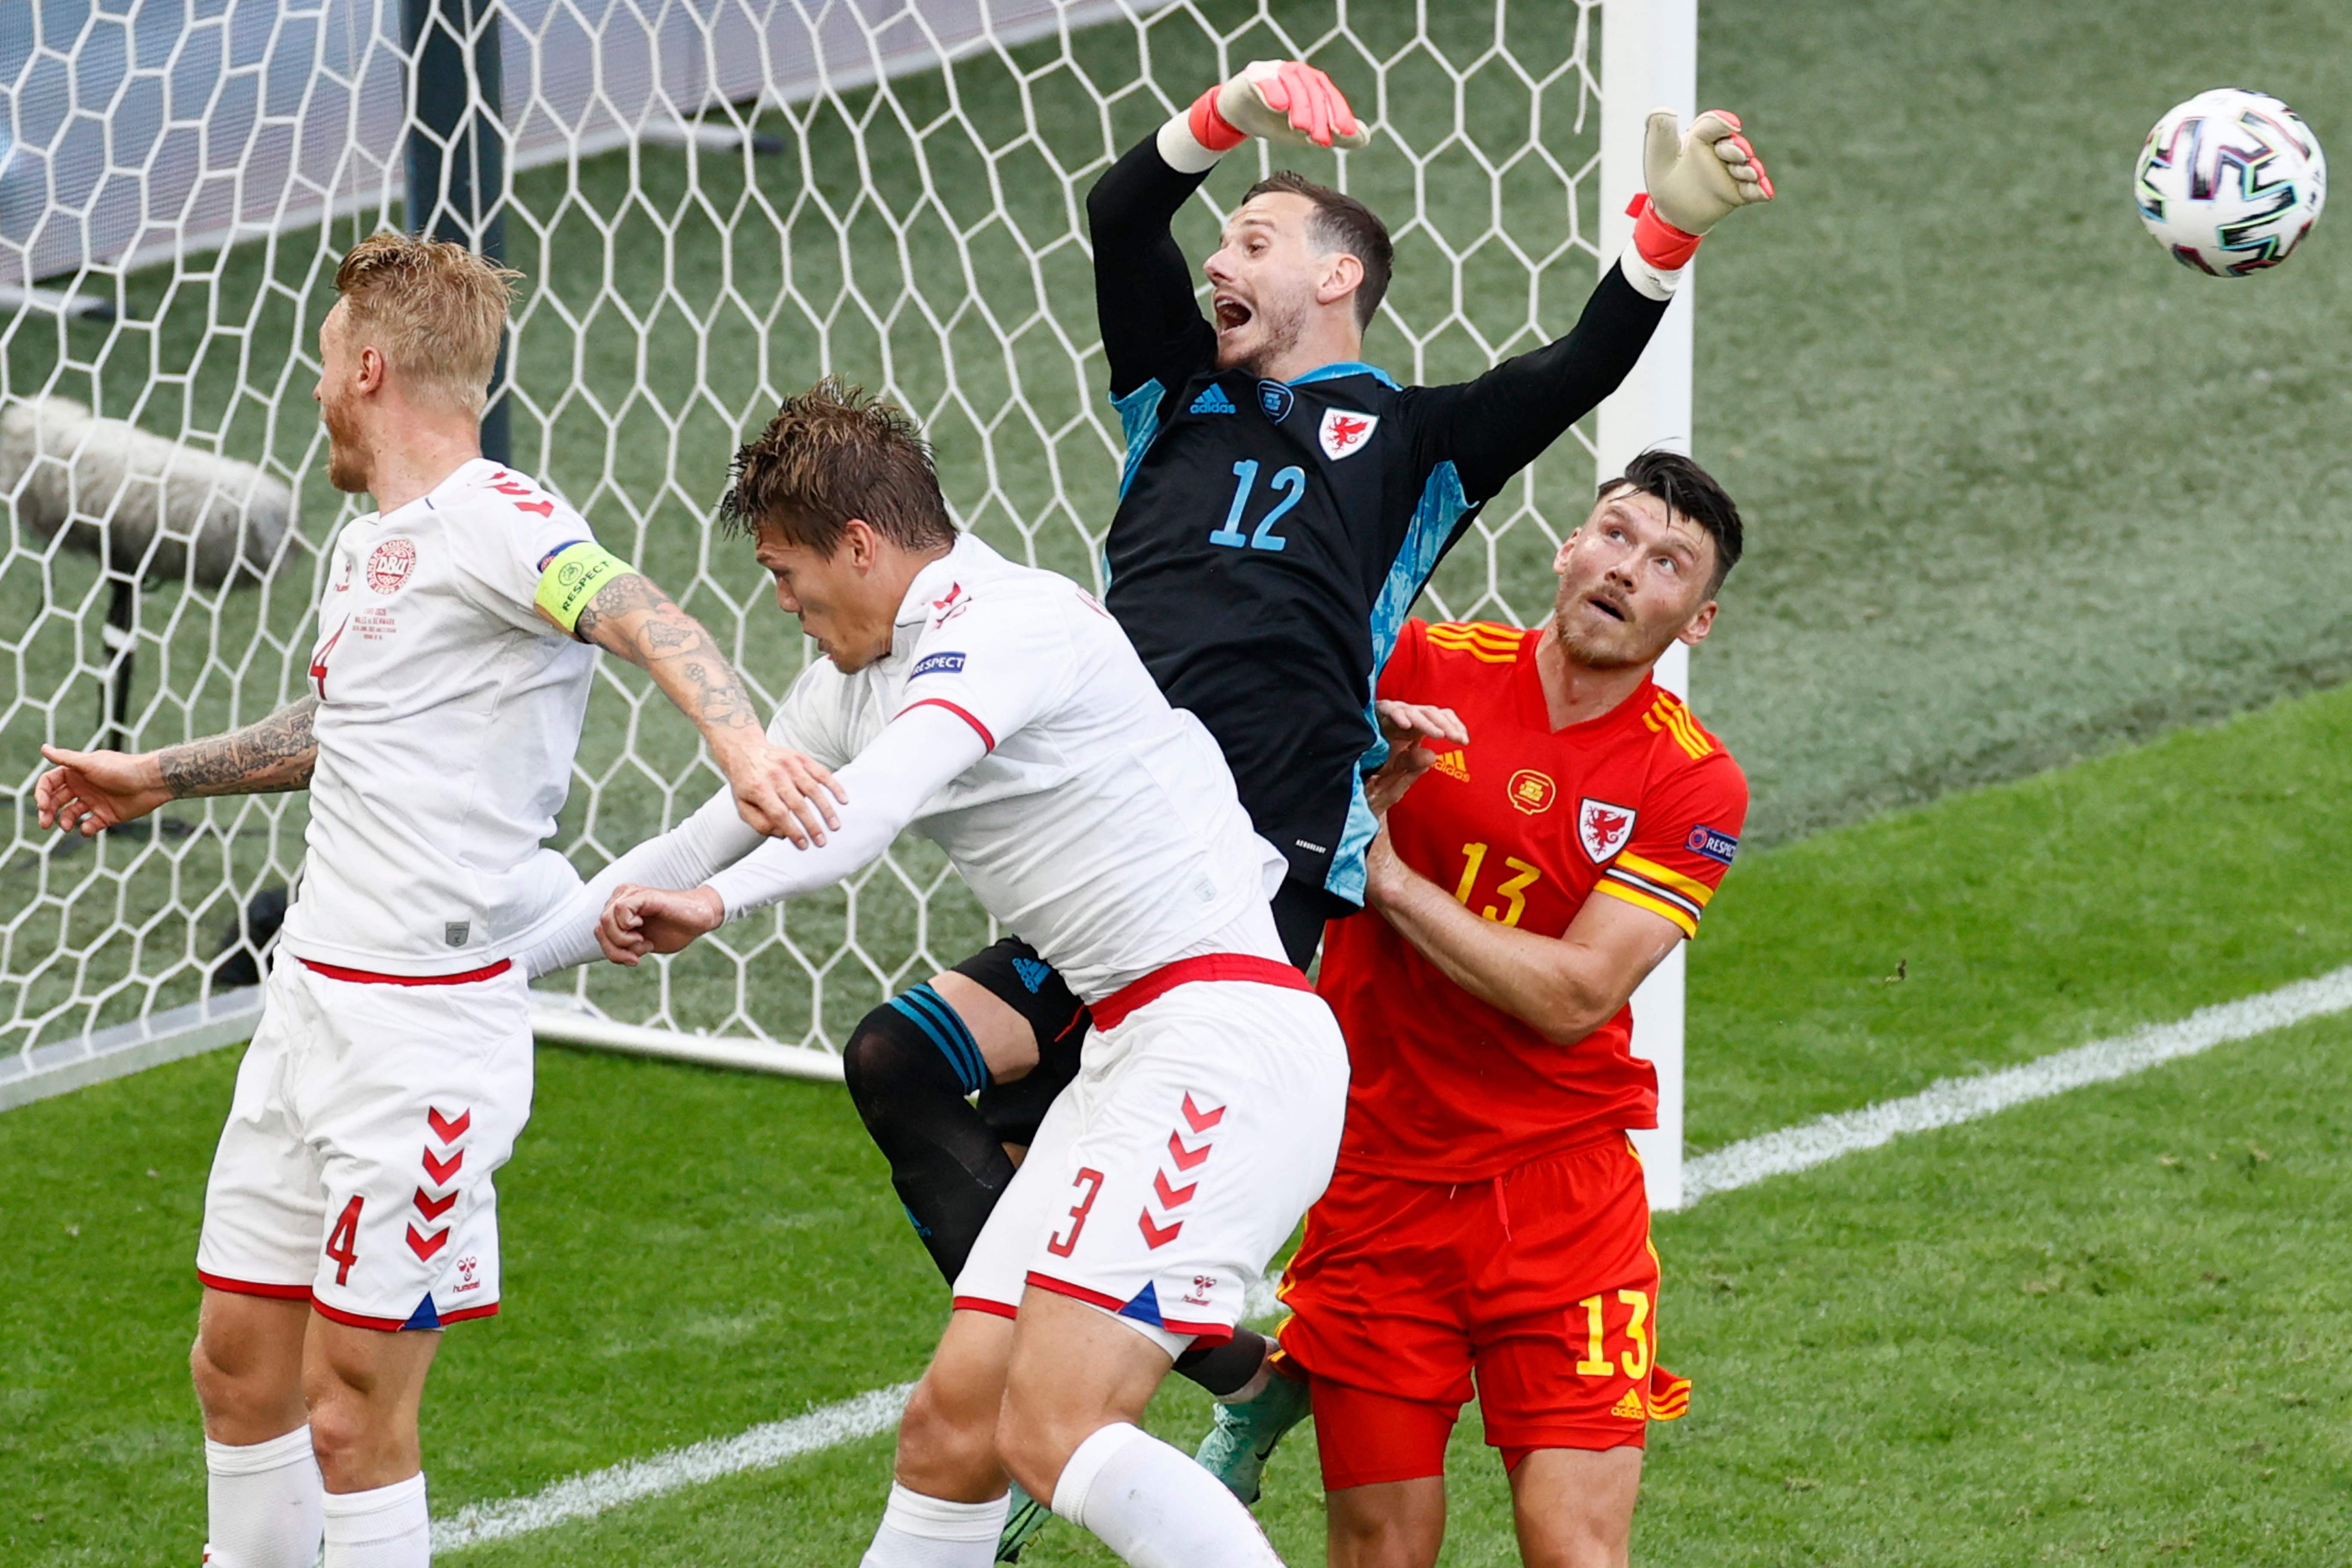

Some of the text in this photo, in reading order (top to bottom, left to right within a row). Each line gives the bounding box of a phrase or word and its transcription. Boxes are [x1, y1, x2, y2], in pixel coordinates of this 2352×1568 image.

[1190, 401, 1236, 414] adidas
[1210, 459, 1305, 551] 12
[377, 556, 408, 575] DBU
[562, 560, 609, 612] RESPECT
[912, 656, 964, 675] RESPECT
[1431, 757, 1470, 783] didas
[1706, 837, 1736, 858] RESPEC
[1455, 842, 1541, 928] 13
[1012, 958, 1038, 994] adidas
[1047, 1167, 1104, 1258] 3
[325, 1194, 364, 1286] 4
[1576, 1289, 1649, 1380] 13
